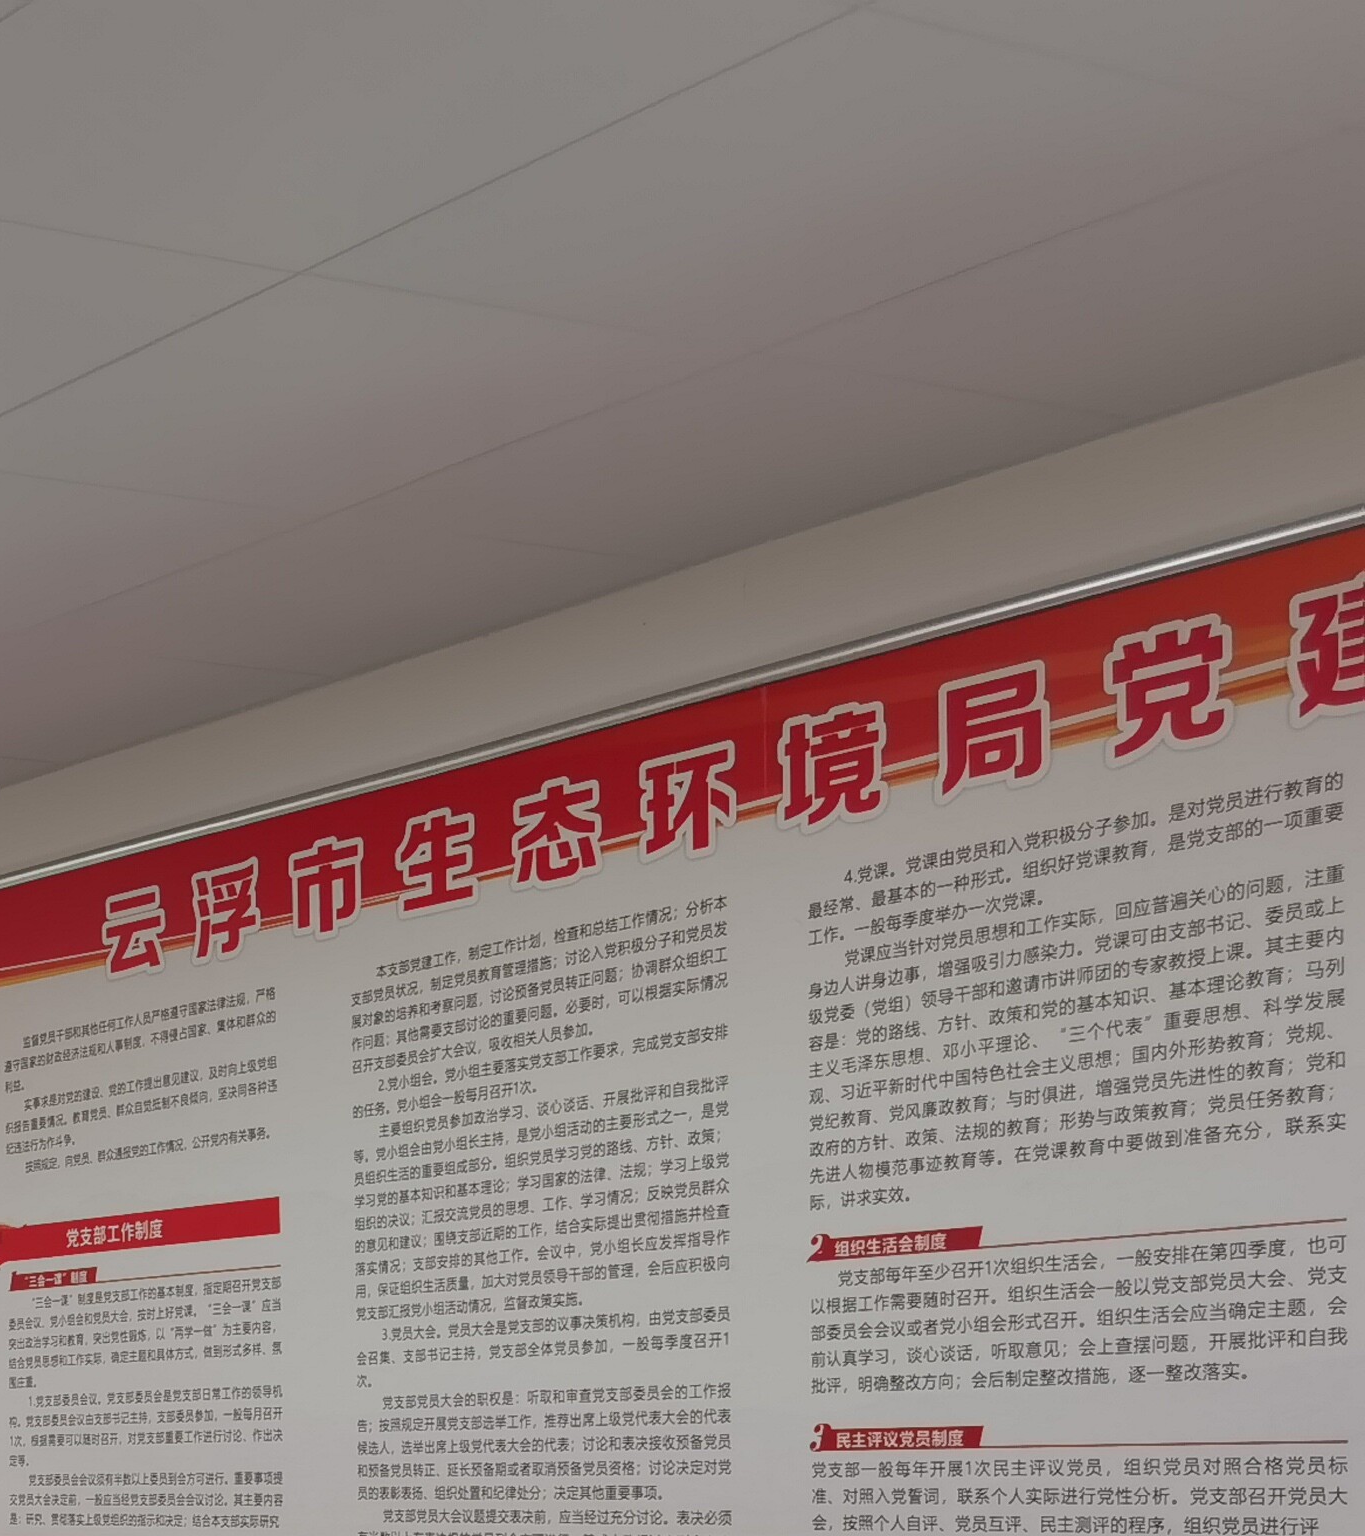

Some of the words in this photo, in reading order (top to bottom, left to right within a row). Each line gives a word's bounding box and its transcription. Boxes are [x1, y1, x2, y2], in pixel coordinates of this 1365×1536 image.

[808, 890, 1045, 946] 工作。一般每季度举办一次党课。
[810, 1187, 912, 1211] 际，讲求实效。
[66, 1219, 163, 1248] 党支部工作制度
[835, 1232, 947, 1257] 组织生活会制度
[357, 1374, 373, 1389] 次。
[836, 1431, 964, 1449] 民主评议党员制度
[811, 1456, 1348, 1478] 党支部一般每年开展1次民主评议党员，组织党员对照合格党员标
[811, 1486, 1348, 1508] 准、对照入党誓词，联系个人实际进行党性分析。党支部召开党员大
[811, 1514, 1319, 1536] 会，按照个人自评、党员互评、民主测评的程序，组织党员进行评
